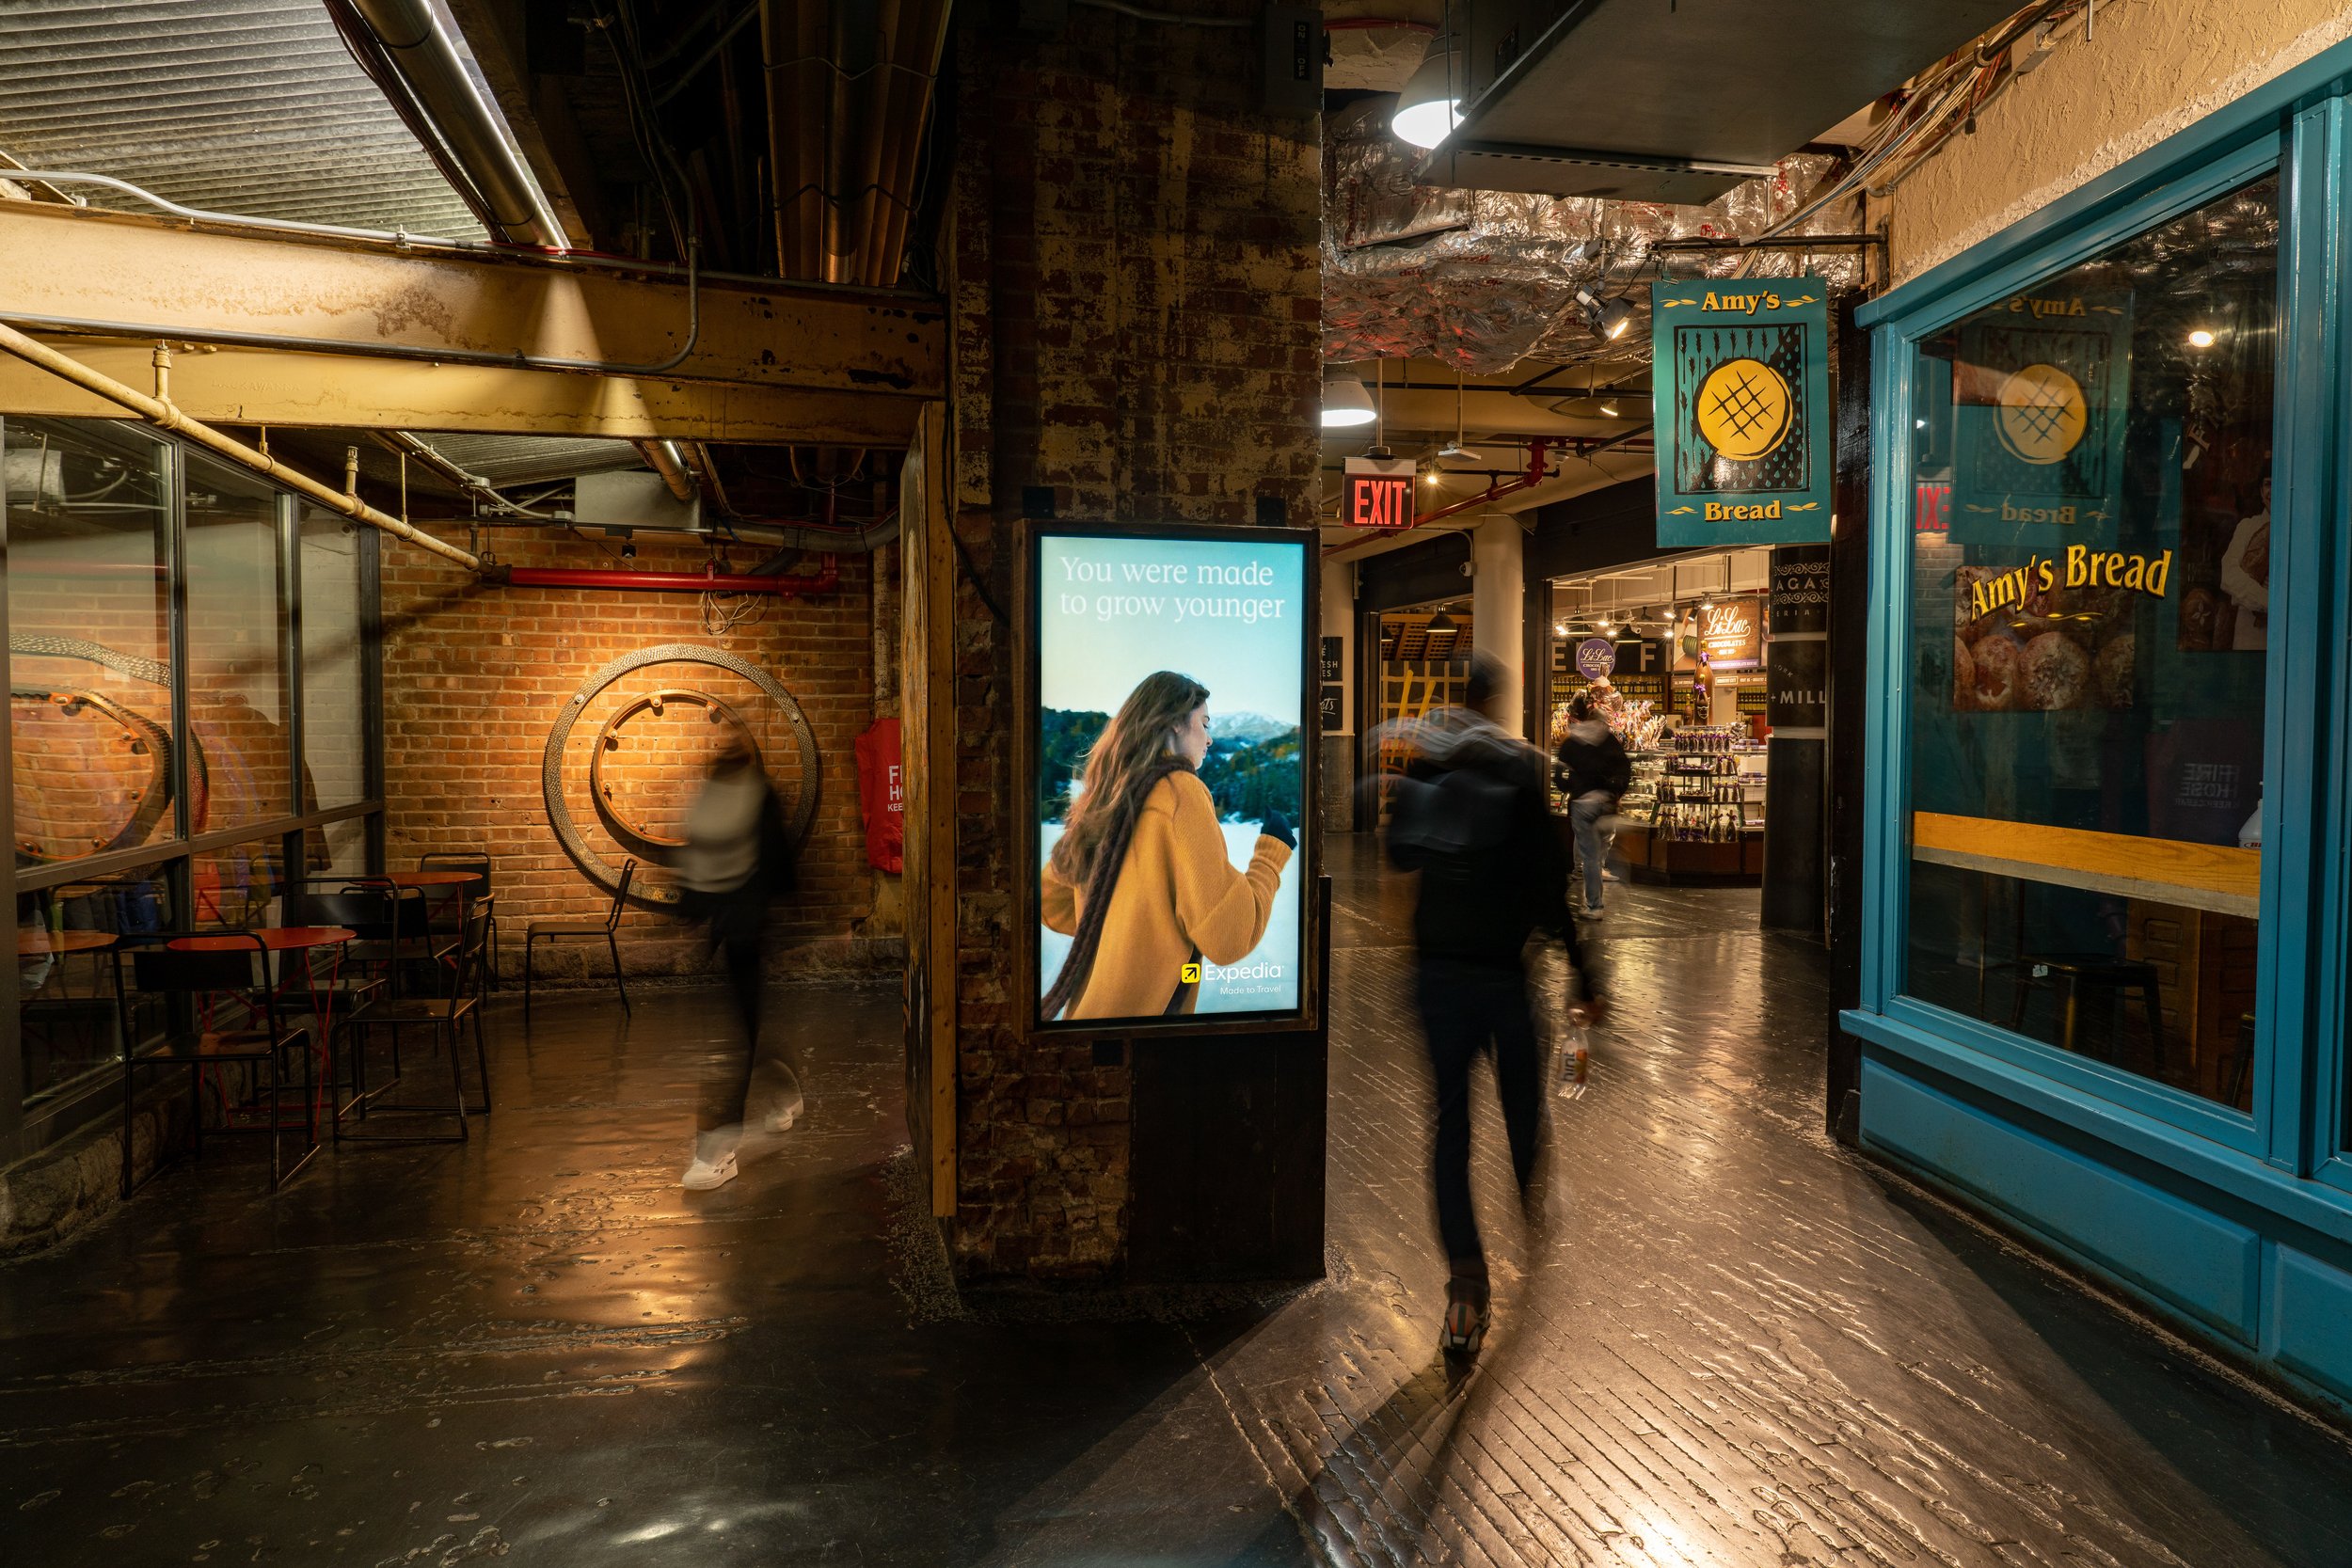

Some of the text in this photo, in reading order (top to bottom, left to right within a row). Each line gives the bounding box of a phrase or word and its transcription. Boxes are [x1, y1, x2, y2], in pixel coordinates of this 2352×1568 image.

[1701, 290, 1782, 316] Amy's
[1354, 480, 1406, 525] EXIT
[1704, 499, 1783, 523] Bread
[1060, 557, 1274, 586] You were made
[1776, 577, 1816, 591] AGA
[1970, 543, 2173, 625] Amy's Bread
[1060, 593, 1285, 624] to grow younger
[1776, 609, 1810, 617] ERIA
[1322, 660, 1339, 669] ESH
[1777, 665, 1794, 678] ORK
[887, 802, 903, 813] KEE
[1205, 962, 1281, 983] Expedia
[1220, 987, 1244, 995] Made
[1257, 985, 1281, 993] Travel
[1561, 1051, 1576, 1083] hint
